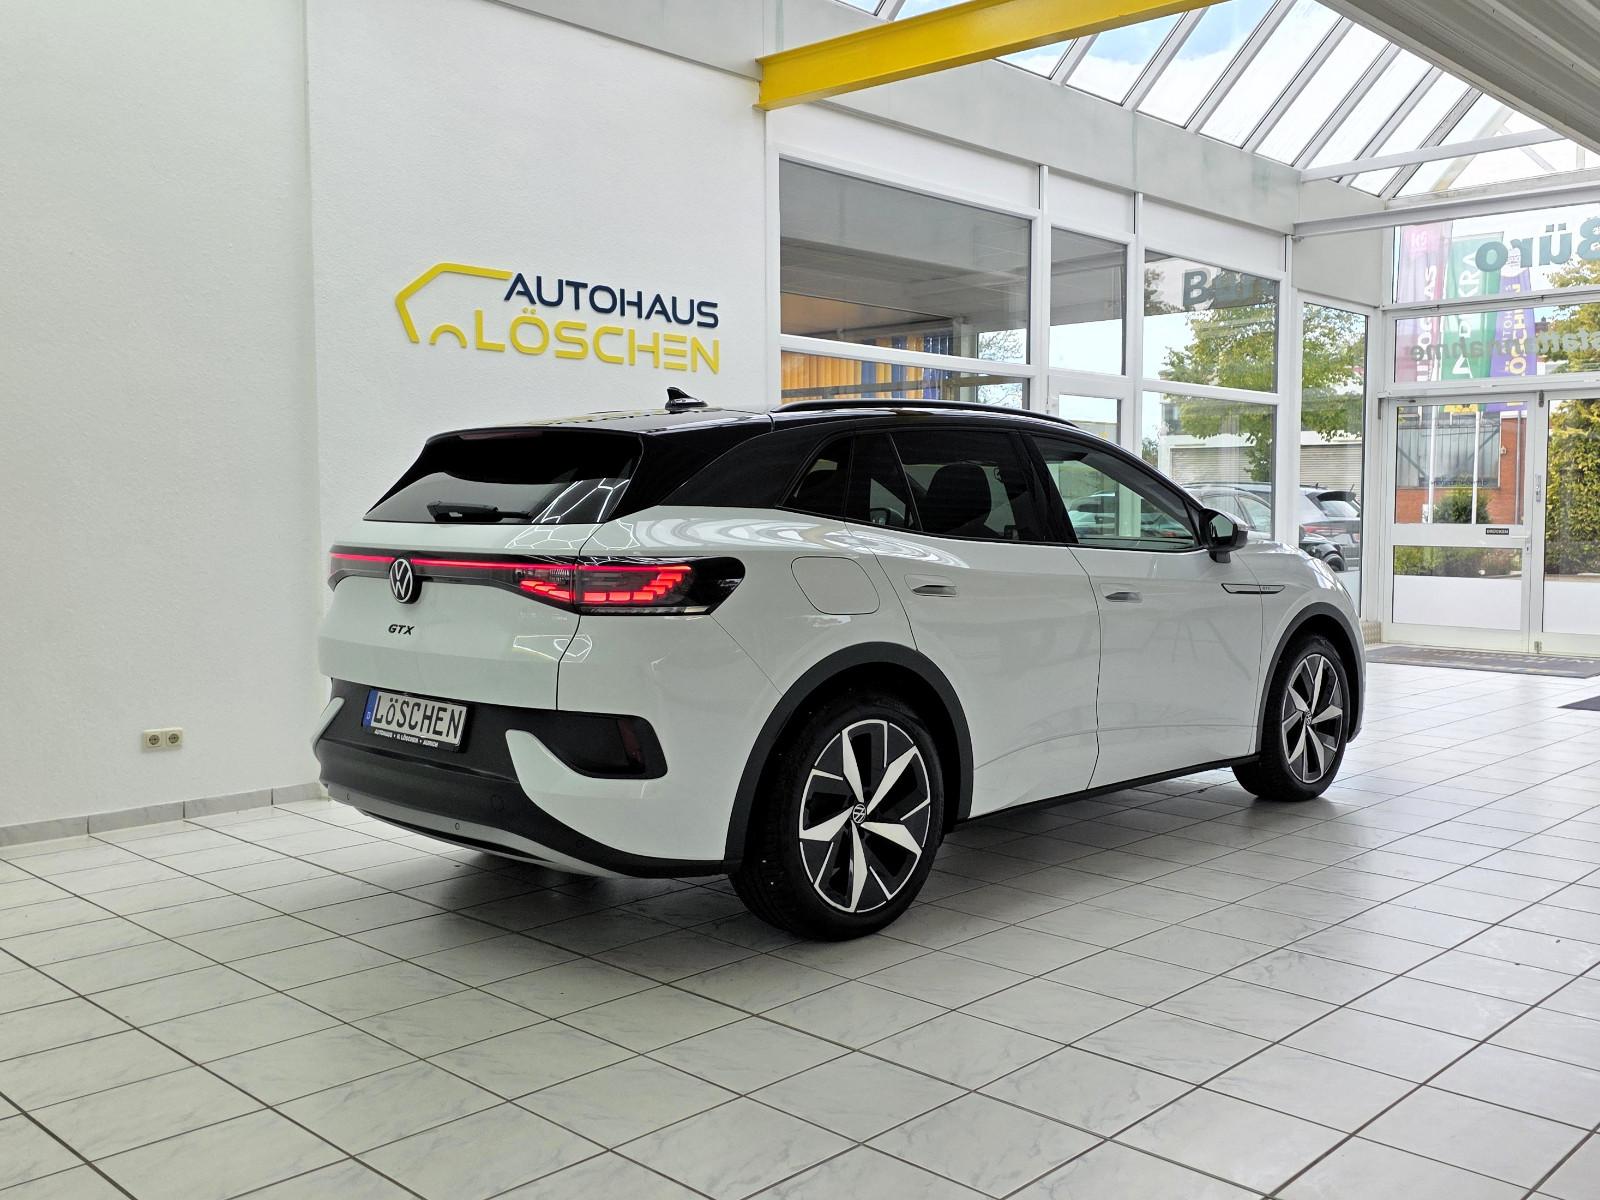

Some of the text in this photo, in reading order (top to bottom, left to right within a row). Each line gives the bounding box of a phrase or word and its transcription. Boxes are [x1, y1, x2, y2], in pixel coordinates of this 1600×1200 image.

[504, 272, 719, 329] AUTOHAUS
[474, 307, 720, 374] LÖSCHEN
[388, 624, 415, 635] GTX
[373, 694, 463, 740] LÖSCHEN
